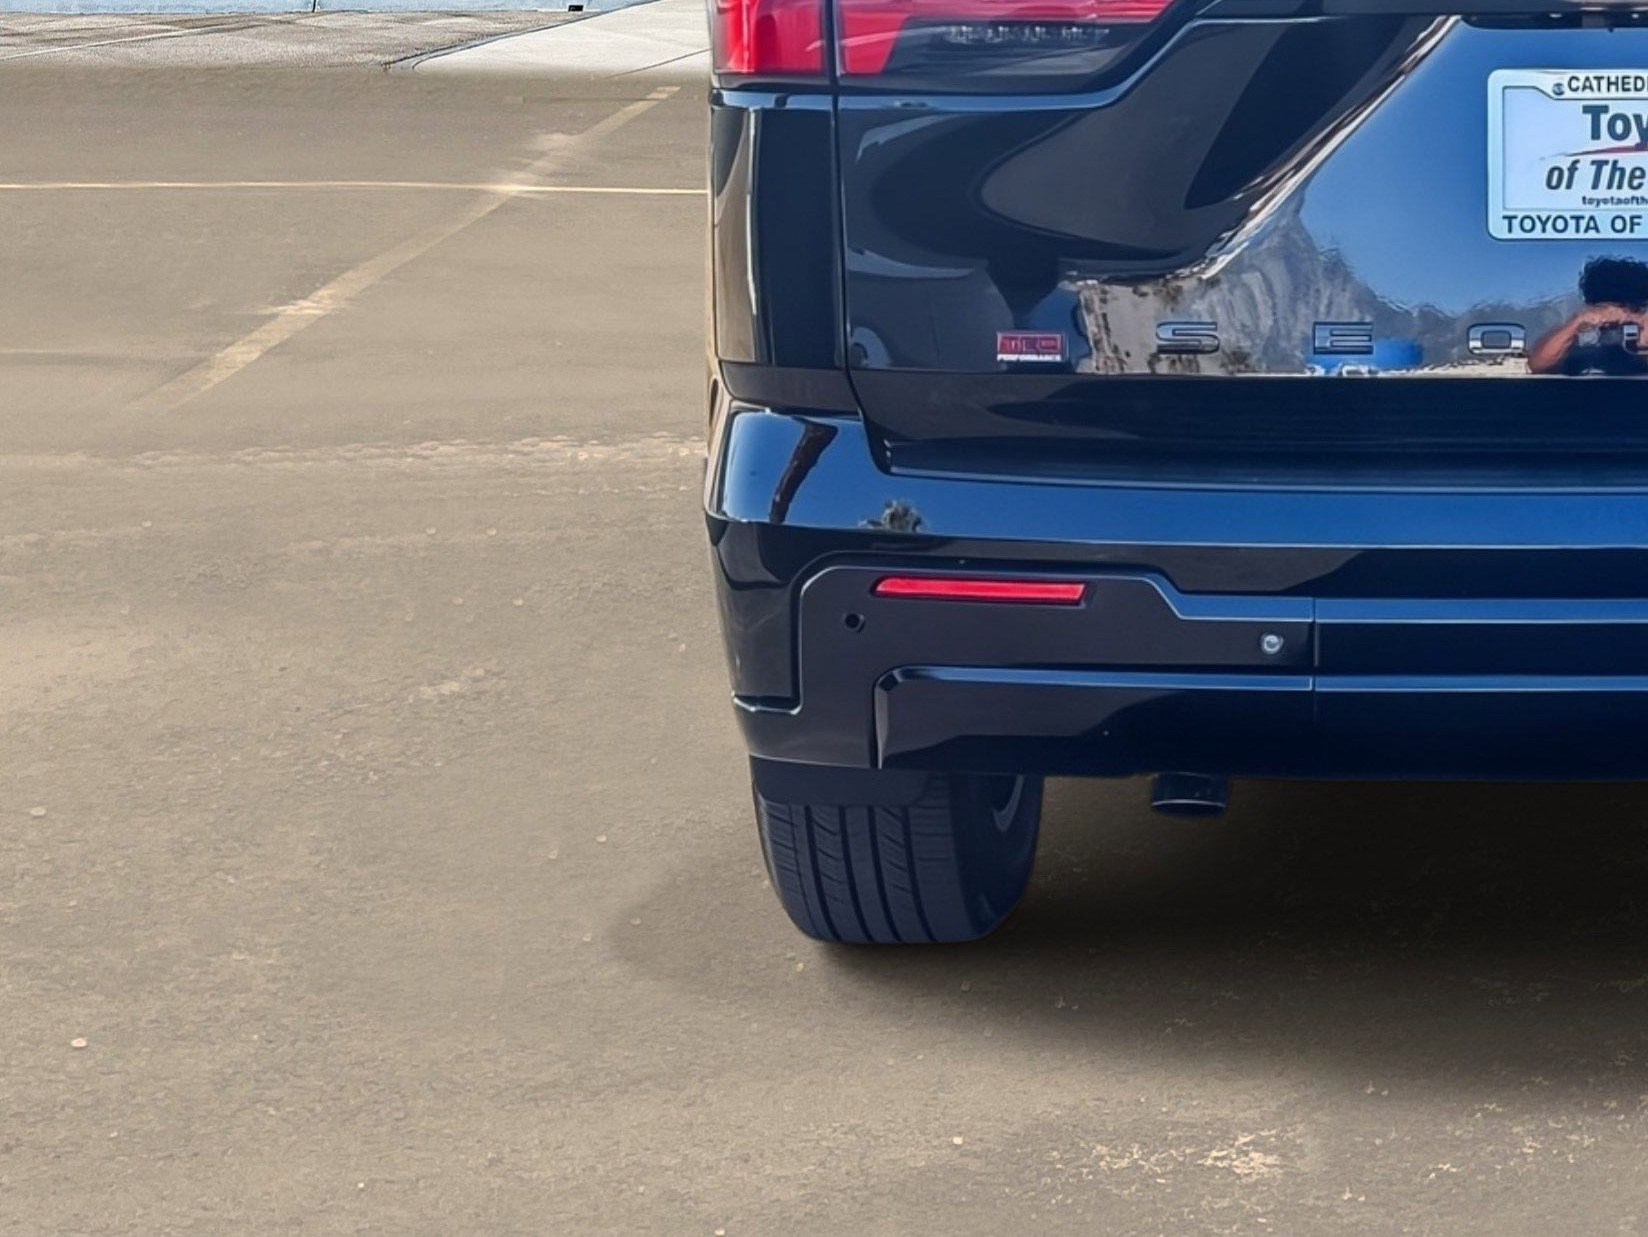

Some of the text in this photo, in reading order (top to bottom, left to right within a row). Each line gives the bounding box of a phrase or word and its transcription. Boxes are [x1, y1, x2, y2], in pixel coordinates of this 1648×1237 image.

[1545, 159, 1581, 191] of
[1589, 159, 1647, 191] The
[1502, 214, 1601, 234] TOYOTA
[1610, 214, 1643, 234] OF
